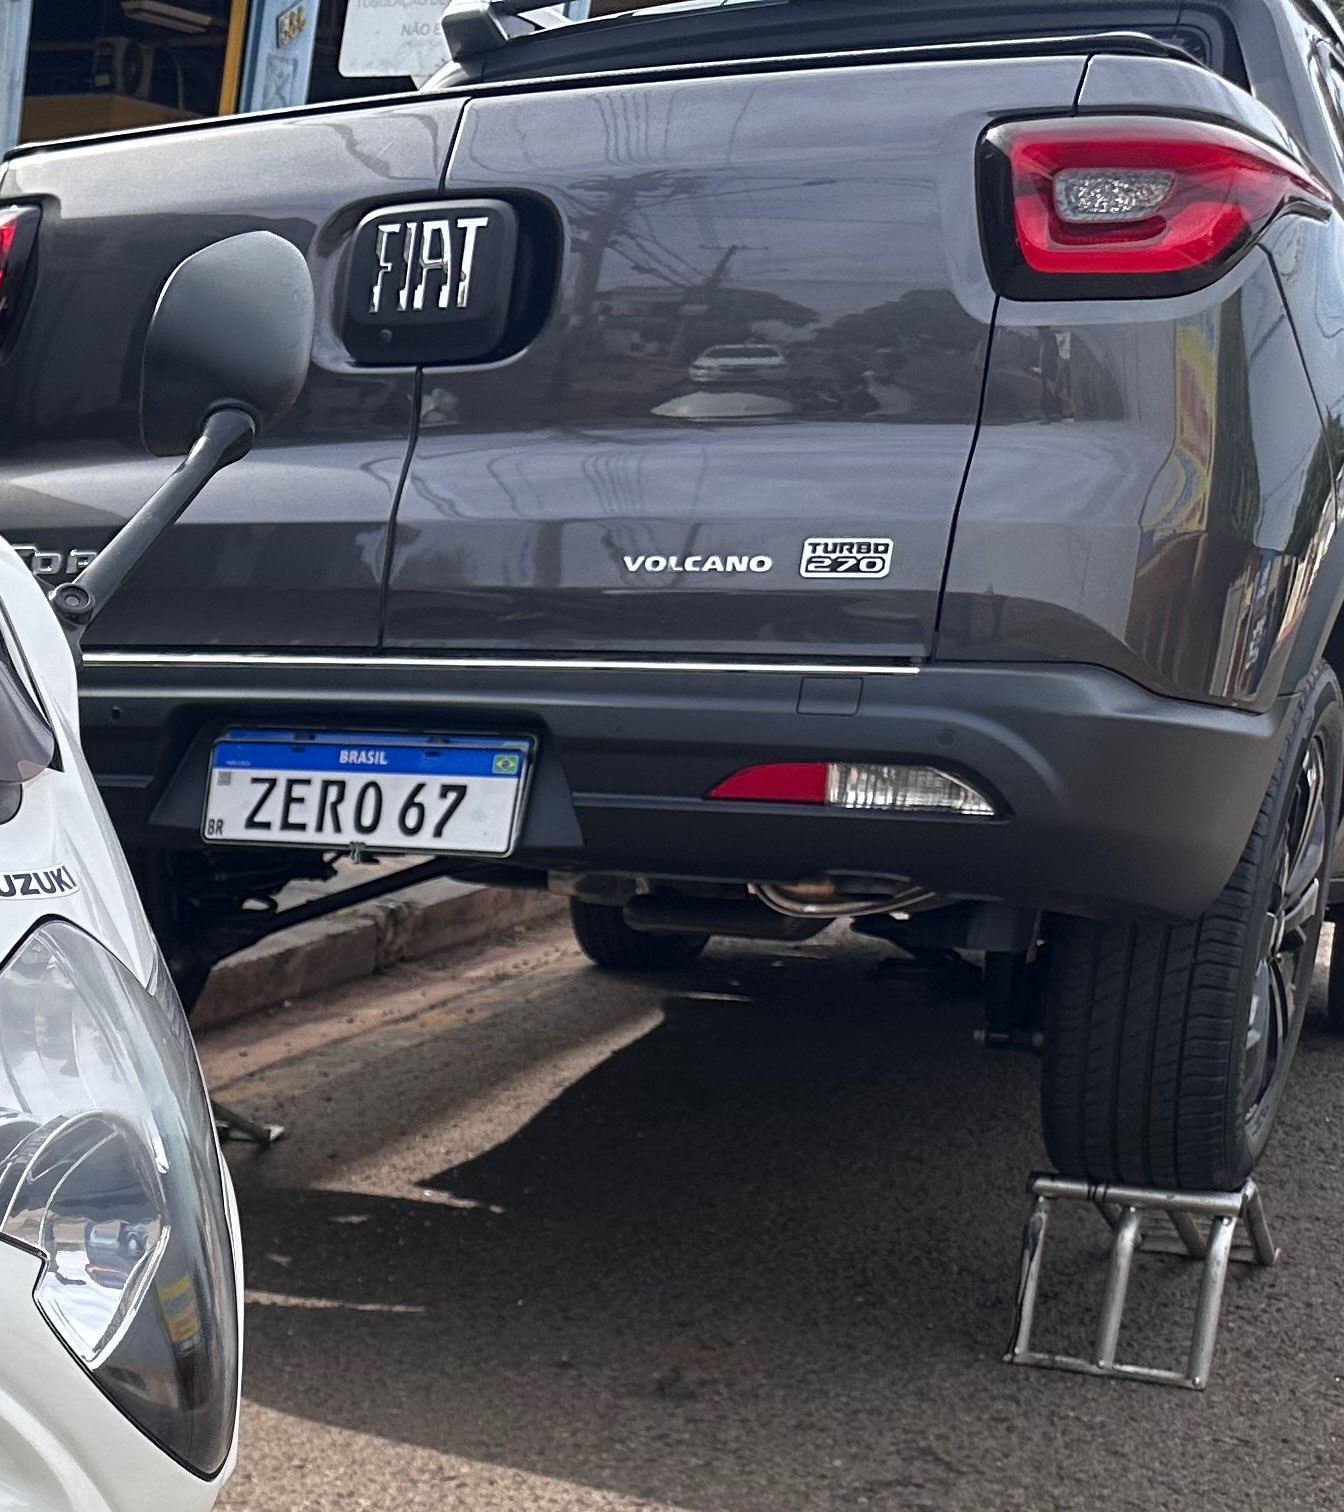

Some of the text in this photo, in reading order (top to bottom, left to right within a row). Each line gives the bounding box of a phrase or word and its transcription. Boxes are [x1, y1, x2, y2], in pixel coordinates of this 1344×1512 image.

[369, 217, 489, 312] FIAT
[808, 541, 891, 555] TURBO
[623, 555, 773, 573] VOLCANO
[806, 557, 885, 573] 270
[339, 749, 388, 766] BRASIL
[244, 776, 468, 839] ZERO 67
[207, 818, 223, 836] BR
